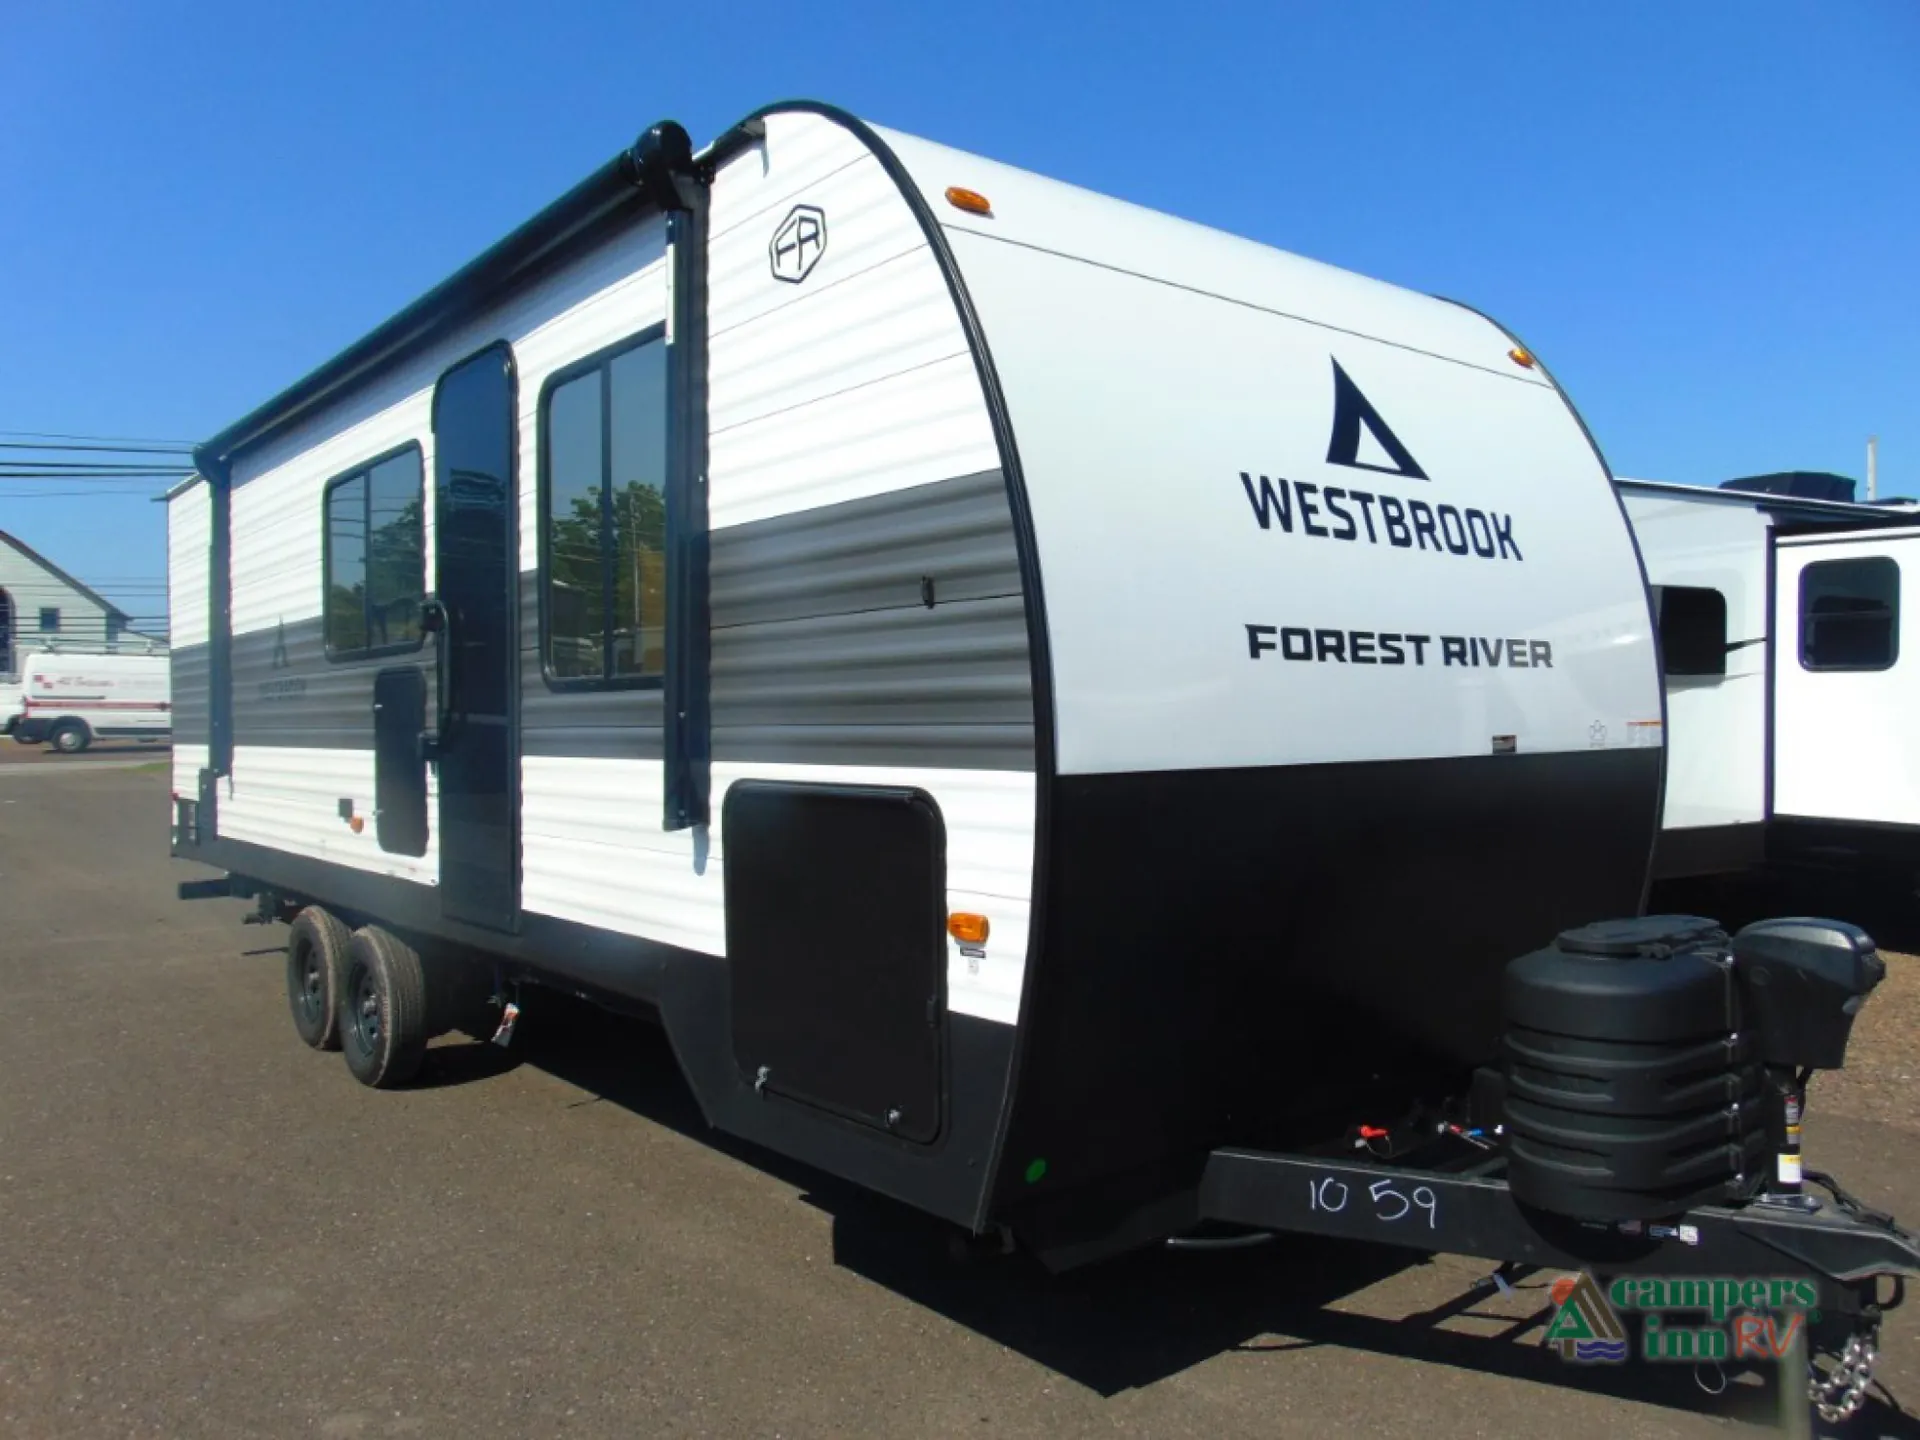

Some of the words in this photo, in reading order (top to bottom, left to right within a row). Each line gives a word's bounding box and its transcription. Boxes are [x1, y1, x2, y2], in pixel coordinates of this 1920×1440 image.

[1239, 471, 1524, 562] WESTBROOK
[1244, 623, 1431, 666] FOREST
[1439, 635, 1554, 669] RIVER
